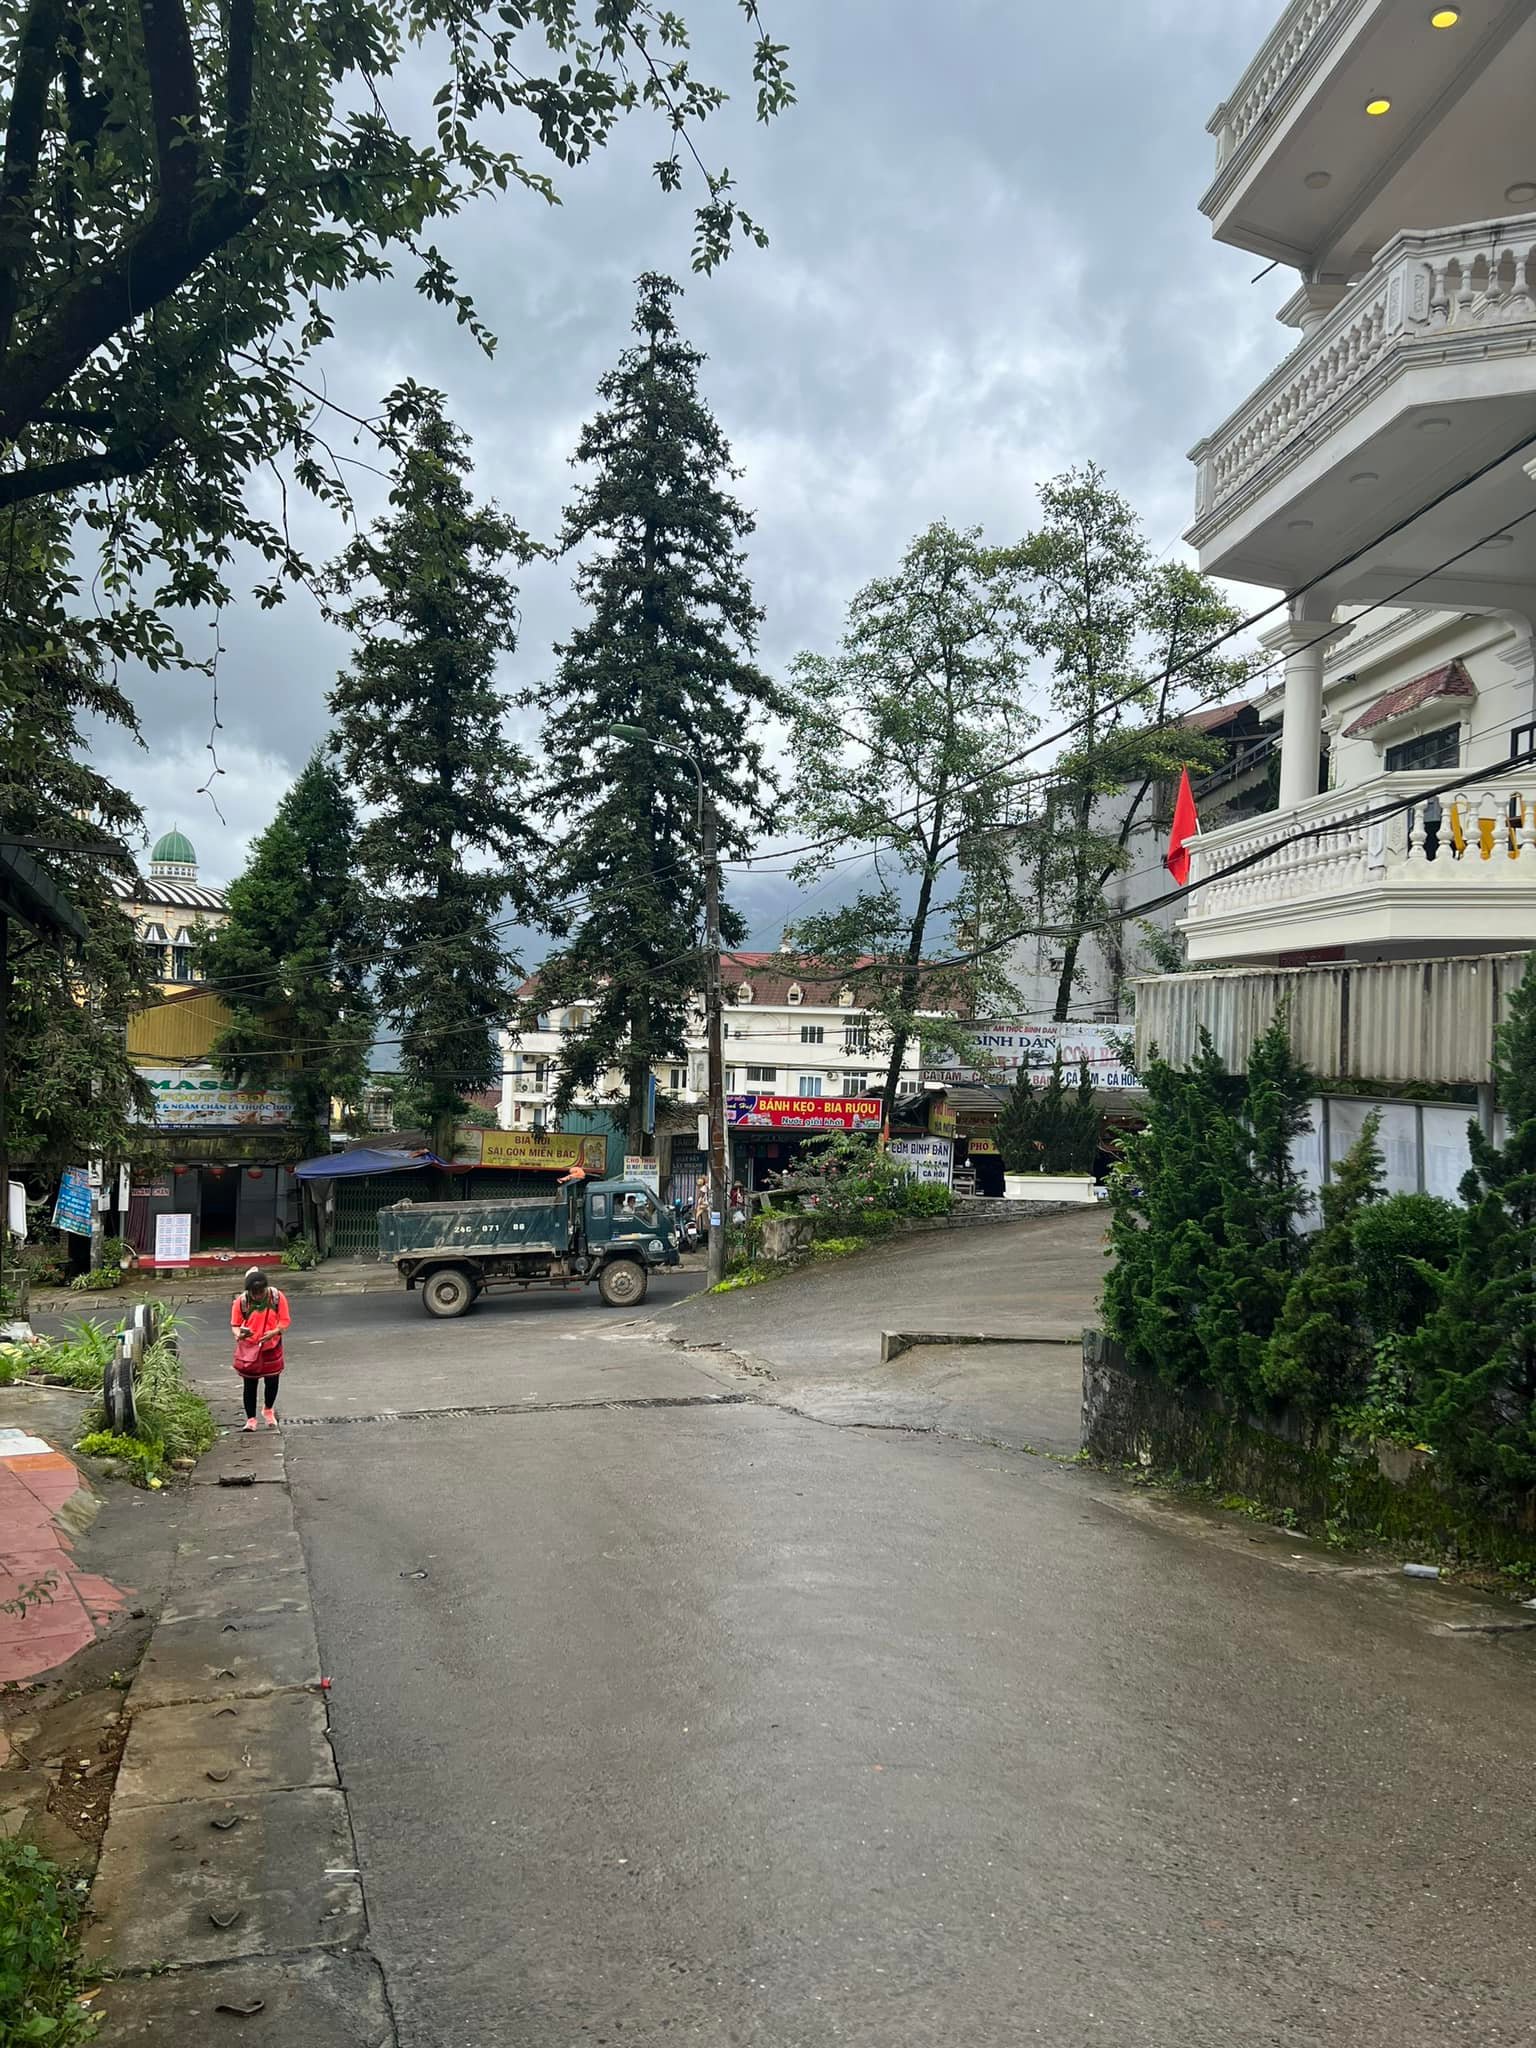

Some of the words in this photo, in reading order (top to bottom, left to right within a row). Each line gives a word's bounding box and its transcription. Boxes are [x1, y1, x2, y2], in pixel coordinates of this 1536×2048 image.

[1018, 1035, 1056, 1049] DÂN
[759, 1097, 790, 1112] BÁNH
[793, 1101, 816, 1116] KẸO
[824, 1102, 843, 1114] BIA
[845, 1102, 877, 1118] RƯỢU
[514, 1135, 531, 1145] BIA
